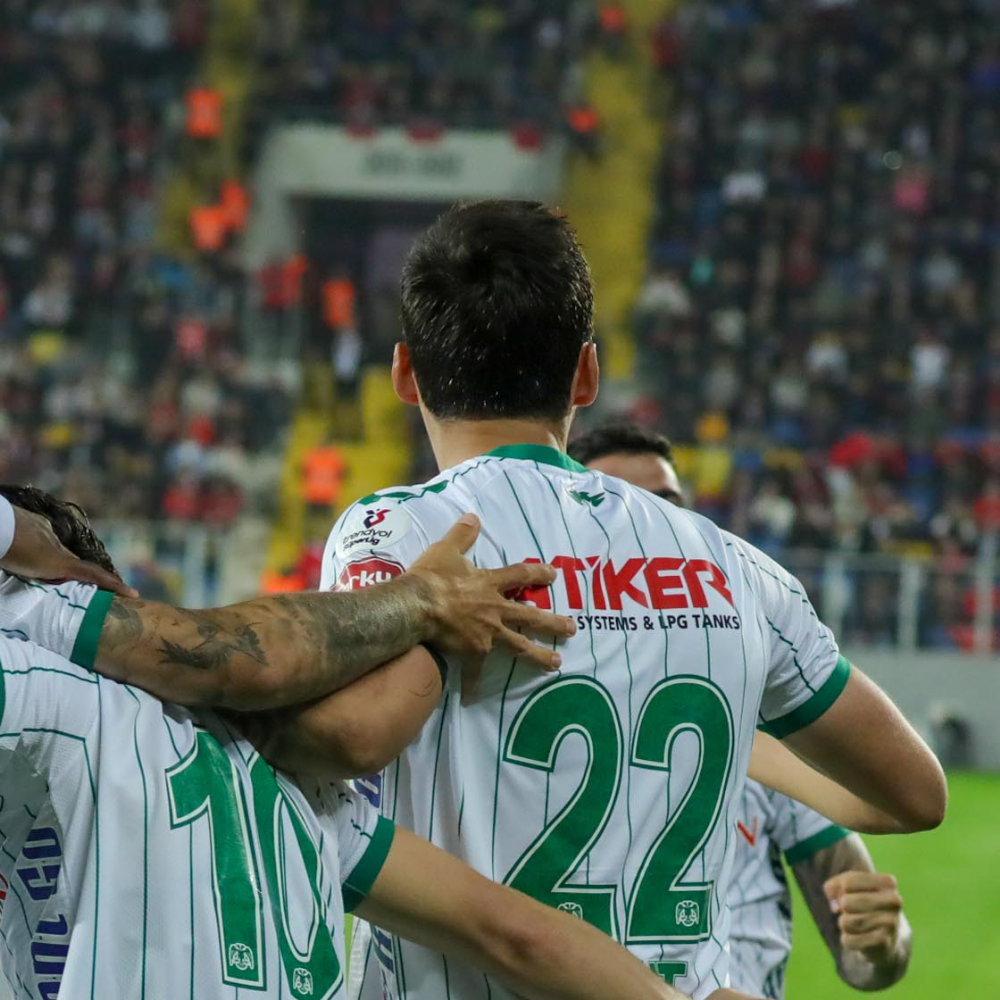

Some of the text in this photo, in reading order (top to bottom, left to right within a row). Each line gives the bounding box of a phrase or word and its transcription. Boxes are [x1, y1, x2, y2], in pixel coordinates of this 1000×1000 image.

[578, 614, 741, 631] SYSTEMS & LPG TANKS
[504, 674, 735, 946] 22
